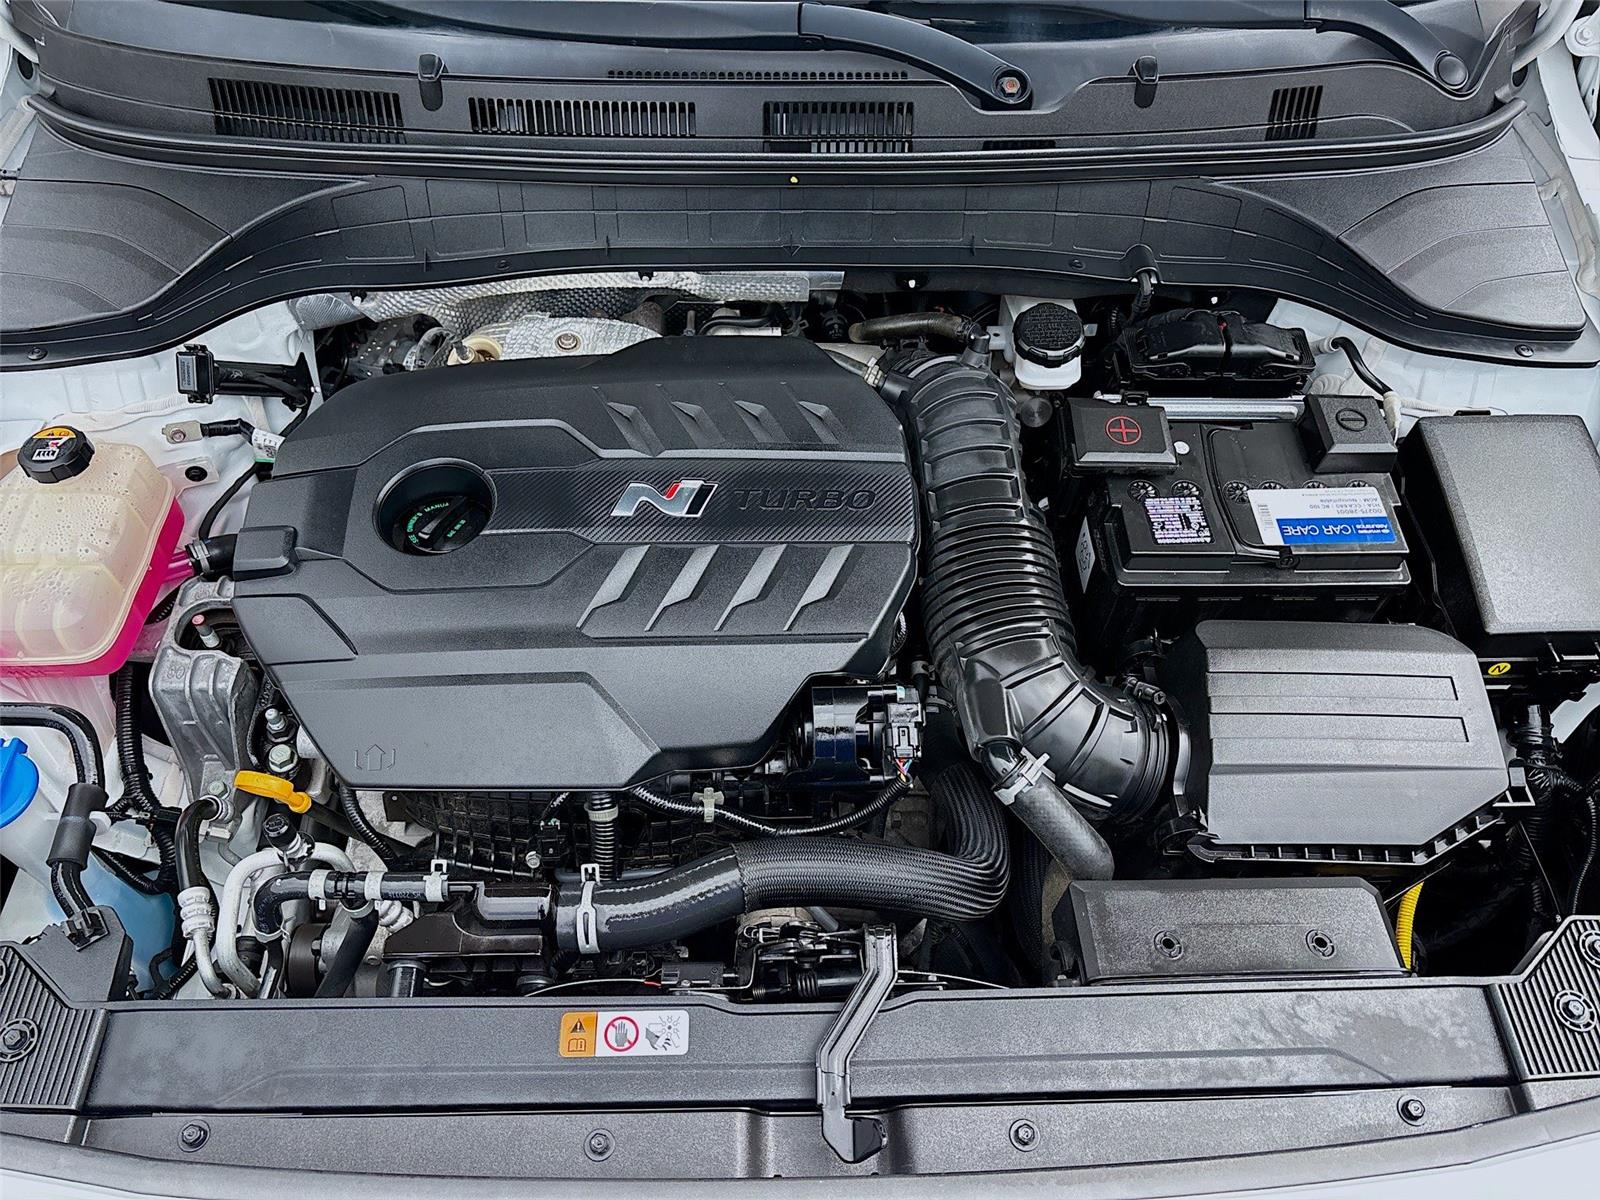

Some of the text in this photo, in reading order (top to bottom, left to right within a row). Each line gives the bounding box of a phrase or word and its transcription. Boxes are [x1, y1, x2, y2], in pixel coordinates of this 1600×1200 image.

[734, 488, 878, 512] TURBO
[1282, 526, 1319, 536] CARE
[1322, 524, 1352, 535] CAR
